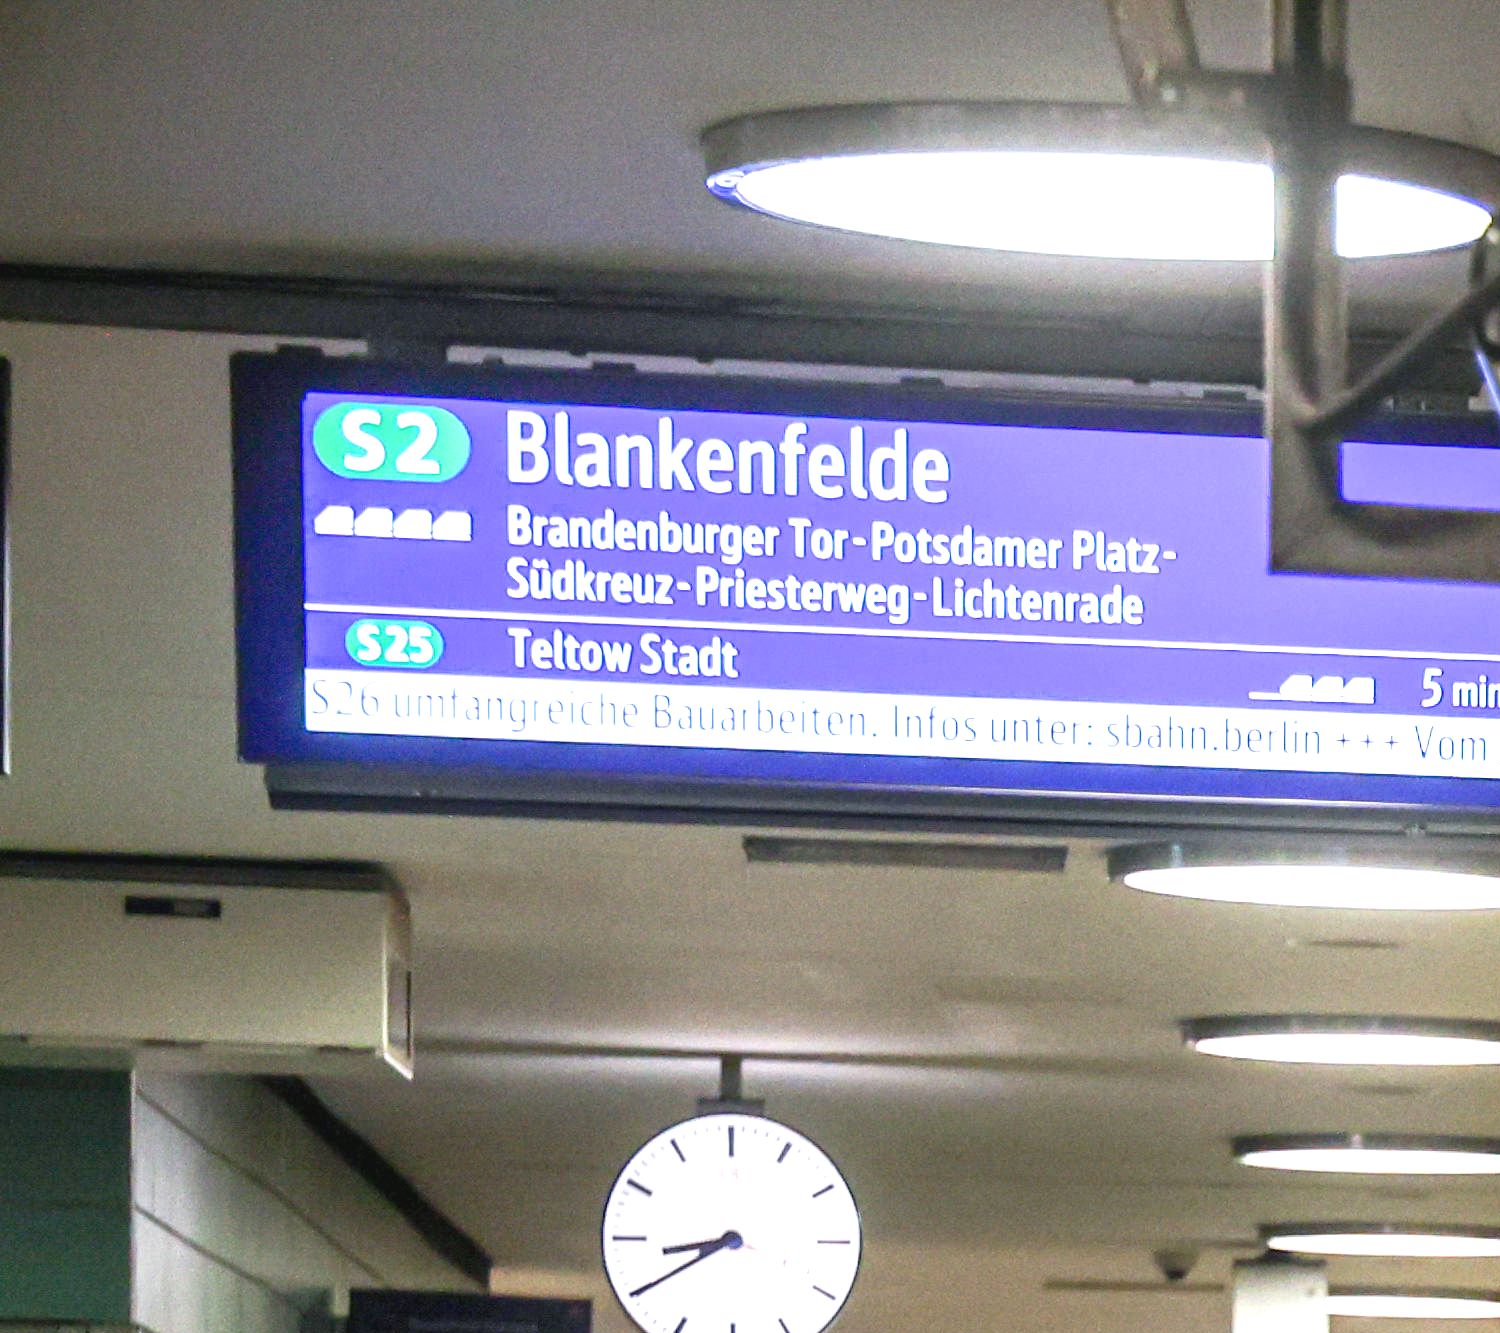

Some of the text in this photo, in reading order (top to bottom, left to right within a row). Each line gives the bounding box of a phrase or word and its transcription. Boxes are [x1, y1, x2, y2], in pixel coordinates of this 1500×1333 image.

[507, 409, 951, 503] Blankenfelde
[507, 503, 780, 565] Brandenburger
[1072, 529, 1177, 574] Platz-
[356, 623, 434, 664] S25
[508, 627, 632, 674] Teltow
[640, 633, 739, 678] Stadt
[1420, 667, 1443, 708] 5
[311, 679, 379, 717] S26
[653, 694, 878, 737] Bauarbeiten.
[894, 704, 977, 742] Infos
[990, 715, 1093, 746] unter:
[1106, 714, 1321, 755] sbahn.berlin
[1414, 725, 1487, 761] Vom
